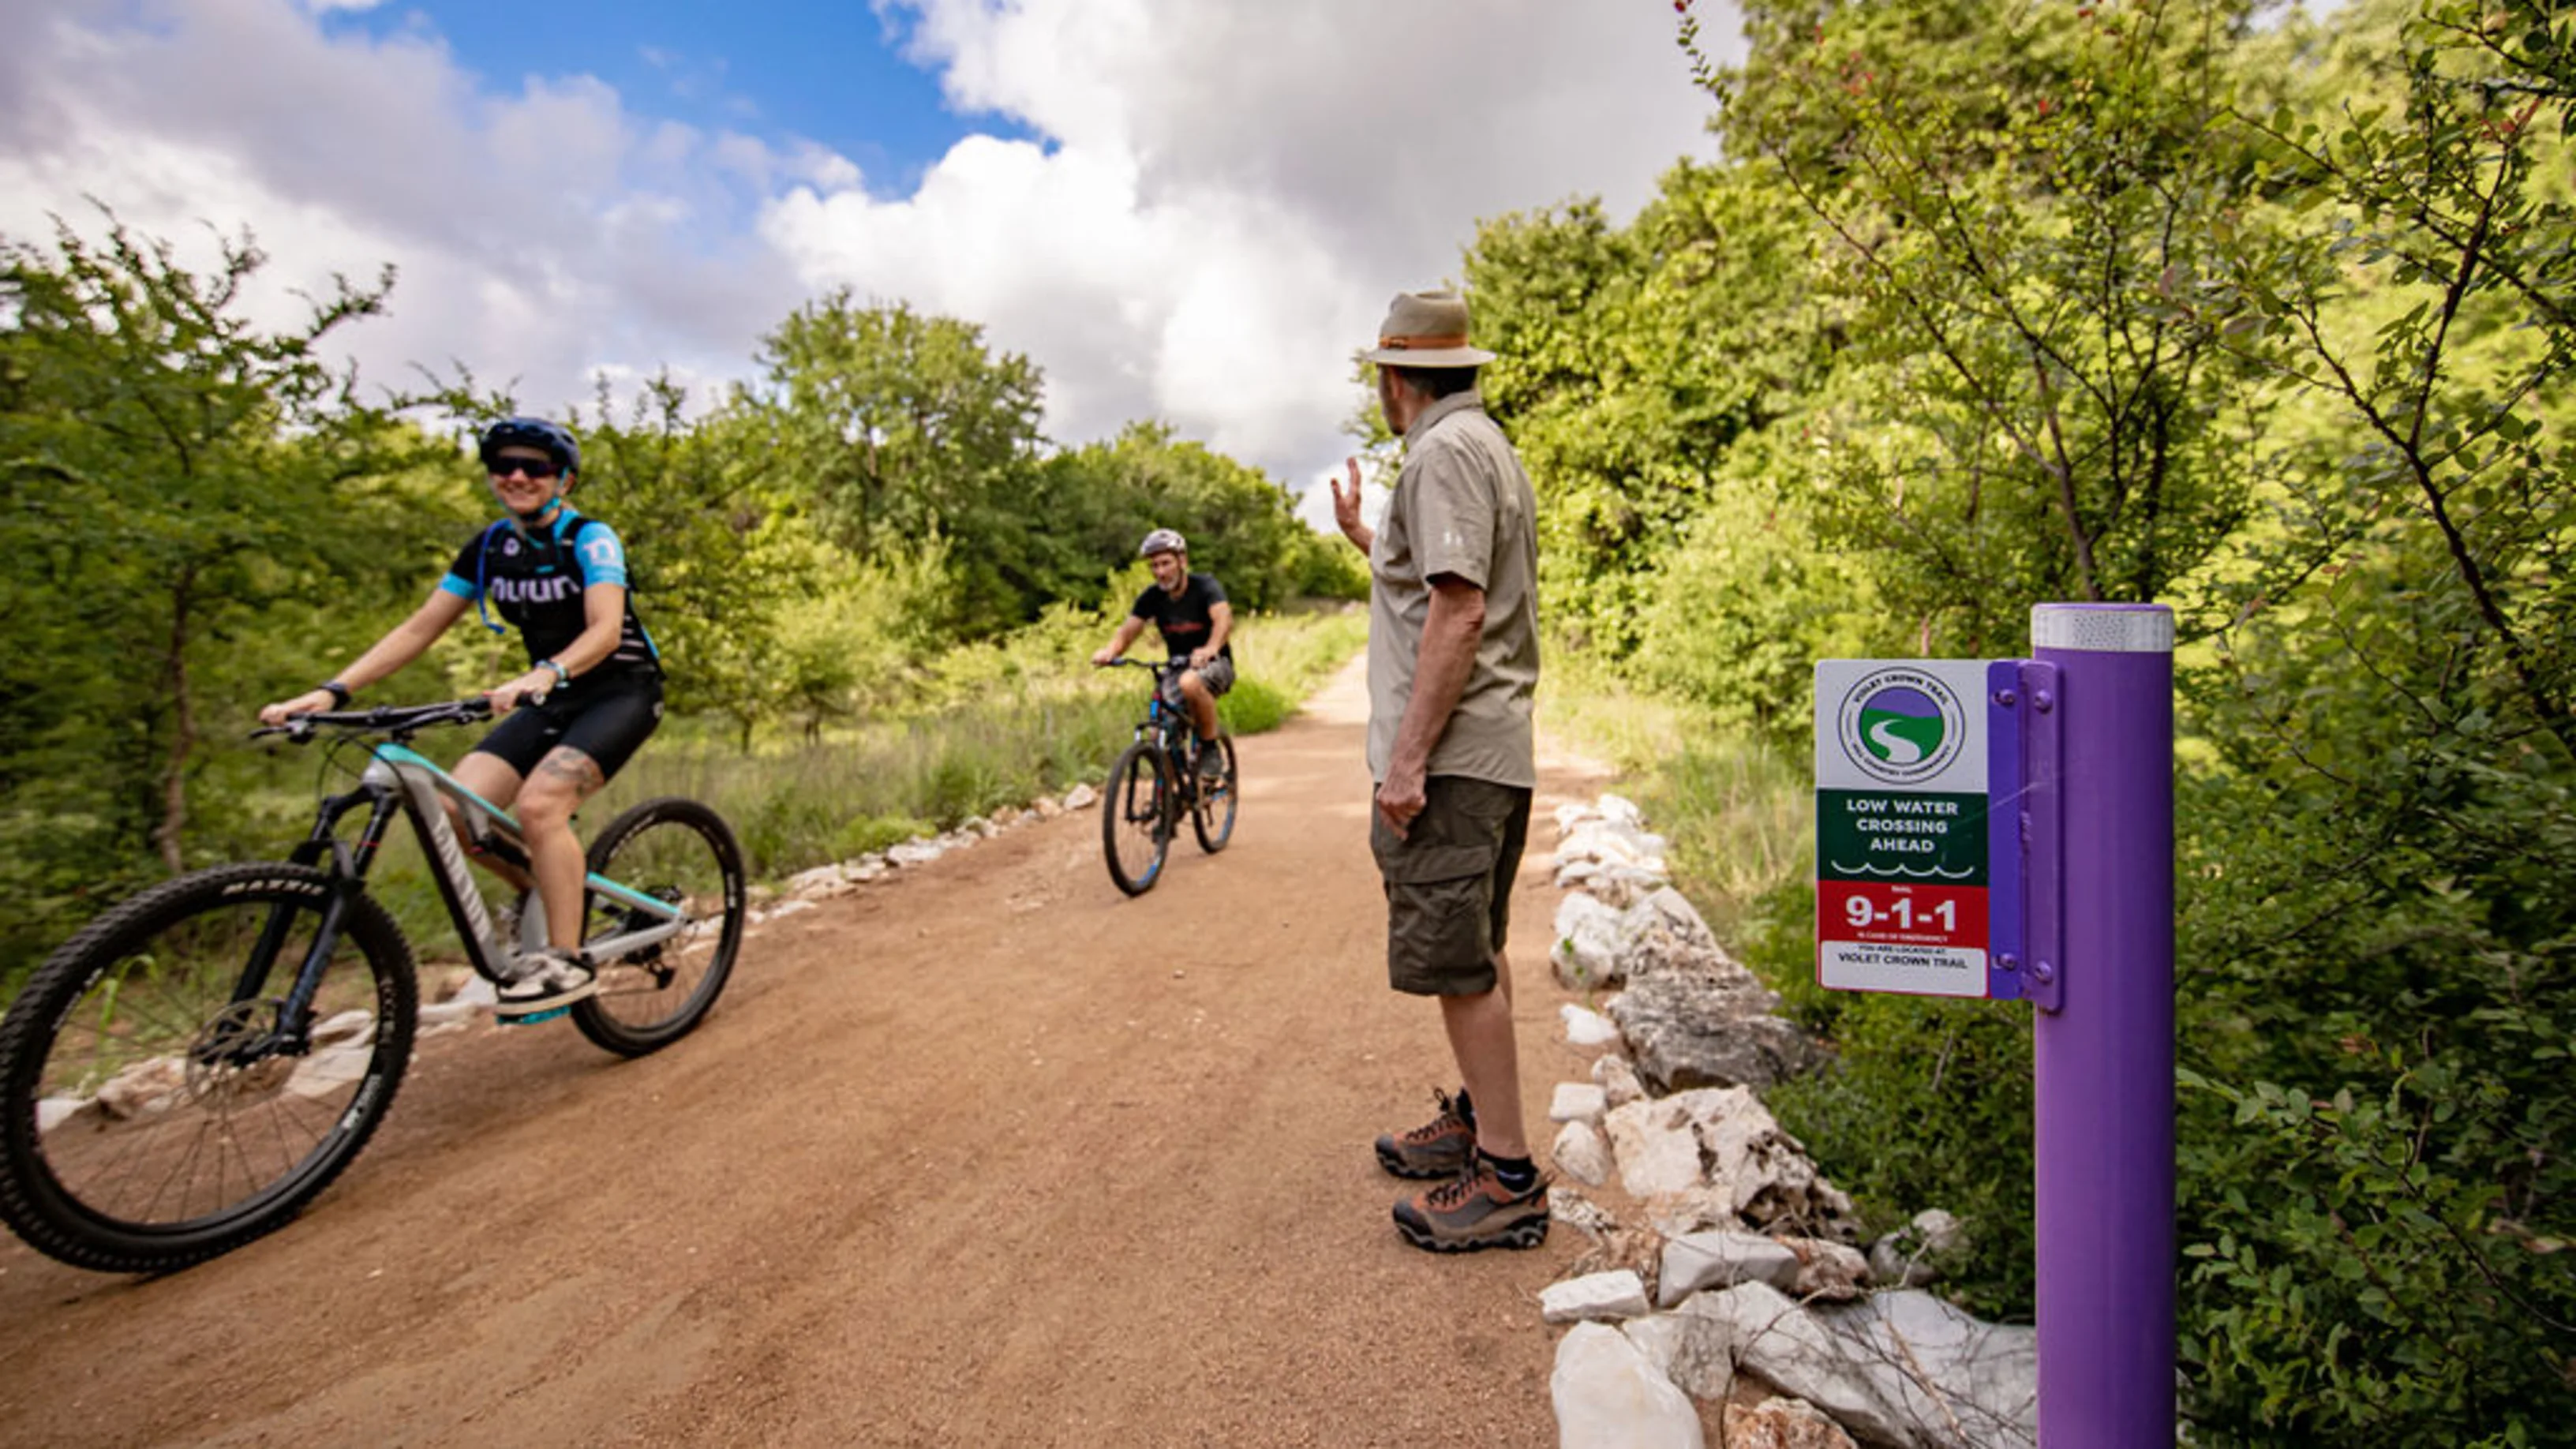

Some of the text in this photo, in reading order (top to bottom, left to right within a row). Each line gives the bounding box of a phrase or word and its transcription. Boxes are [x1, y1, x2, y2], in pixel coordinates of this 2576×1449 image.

[1885, 675, 1924, 685] CROWN
[1846, 799, 1959, 815] LOW WATER
[1856, 818, 1949, 834] CROSSING
[1870, 837, 1935, 853] AHEAD
[1845, 895, 1956, 932] 9-1-1
[1838, 953, 1968, 968] VIOLET CROWN TRAIL
